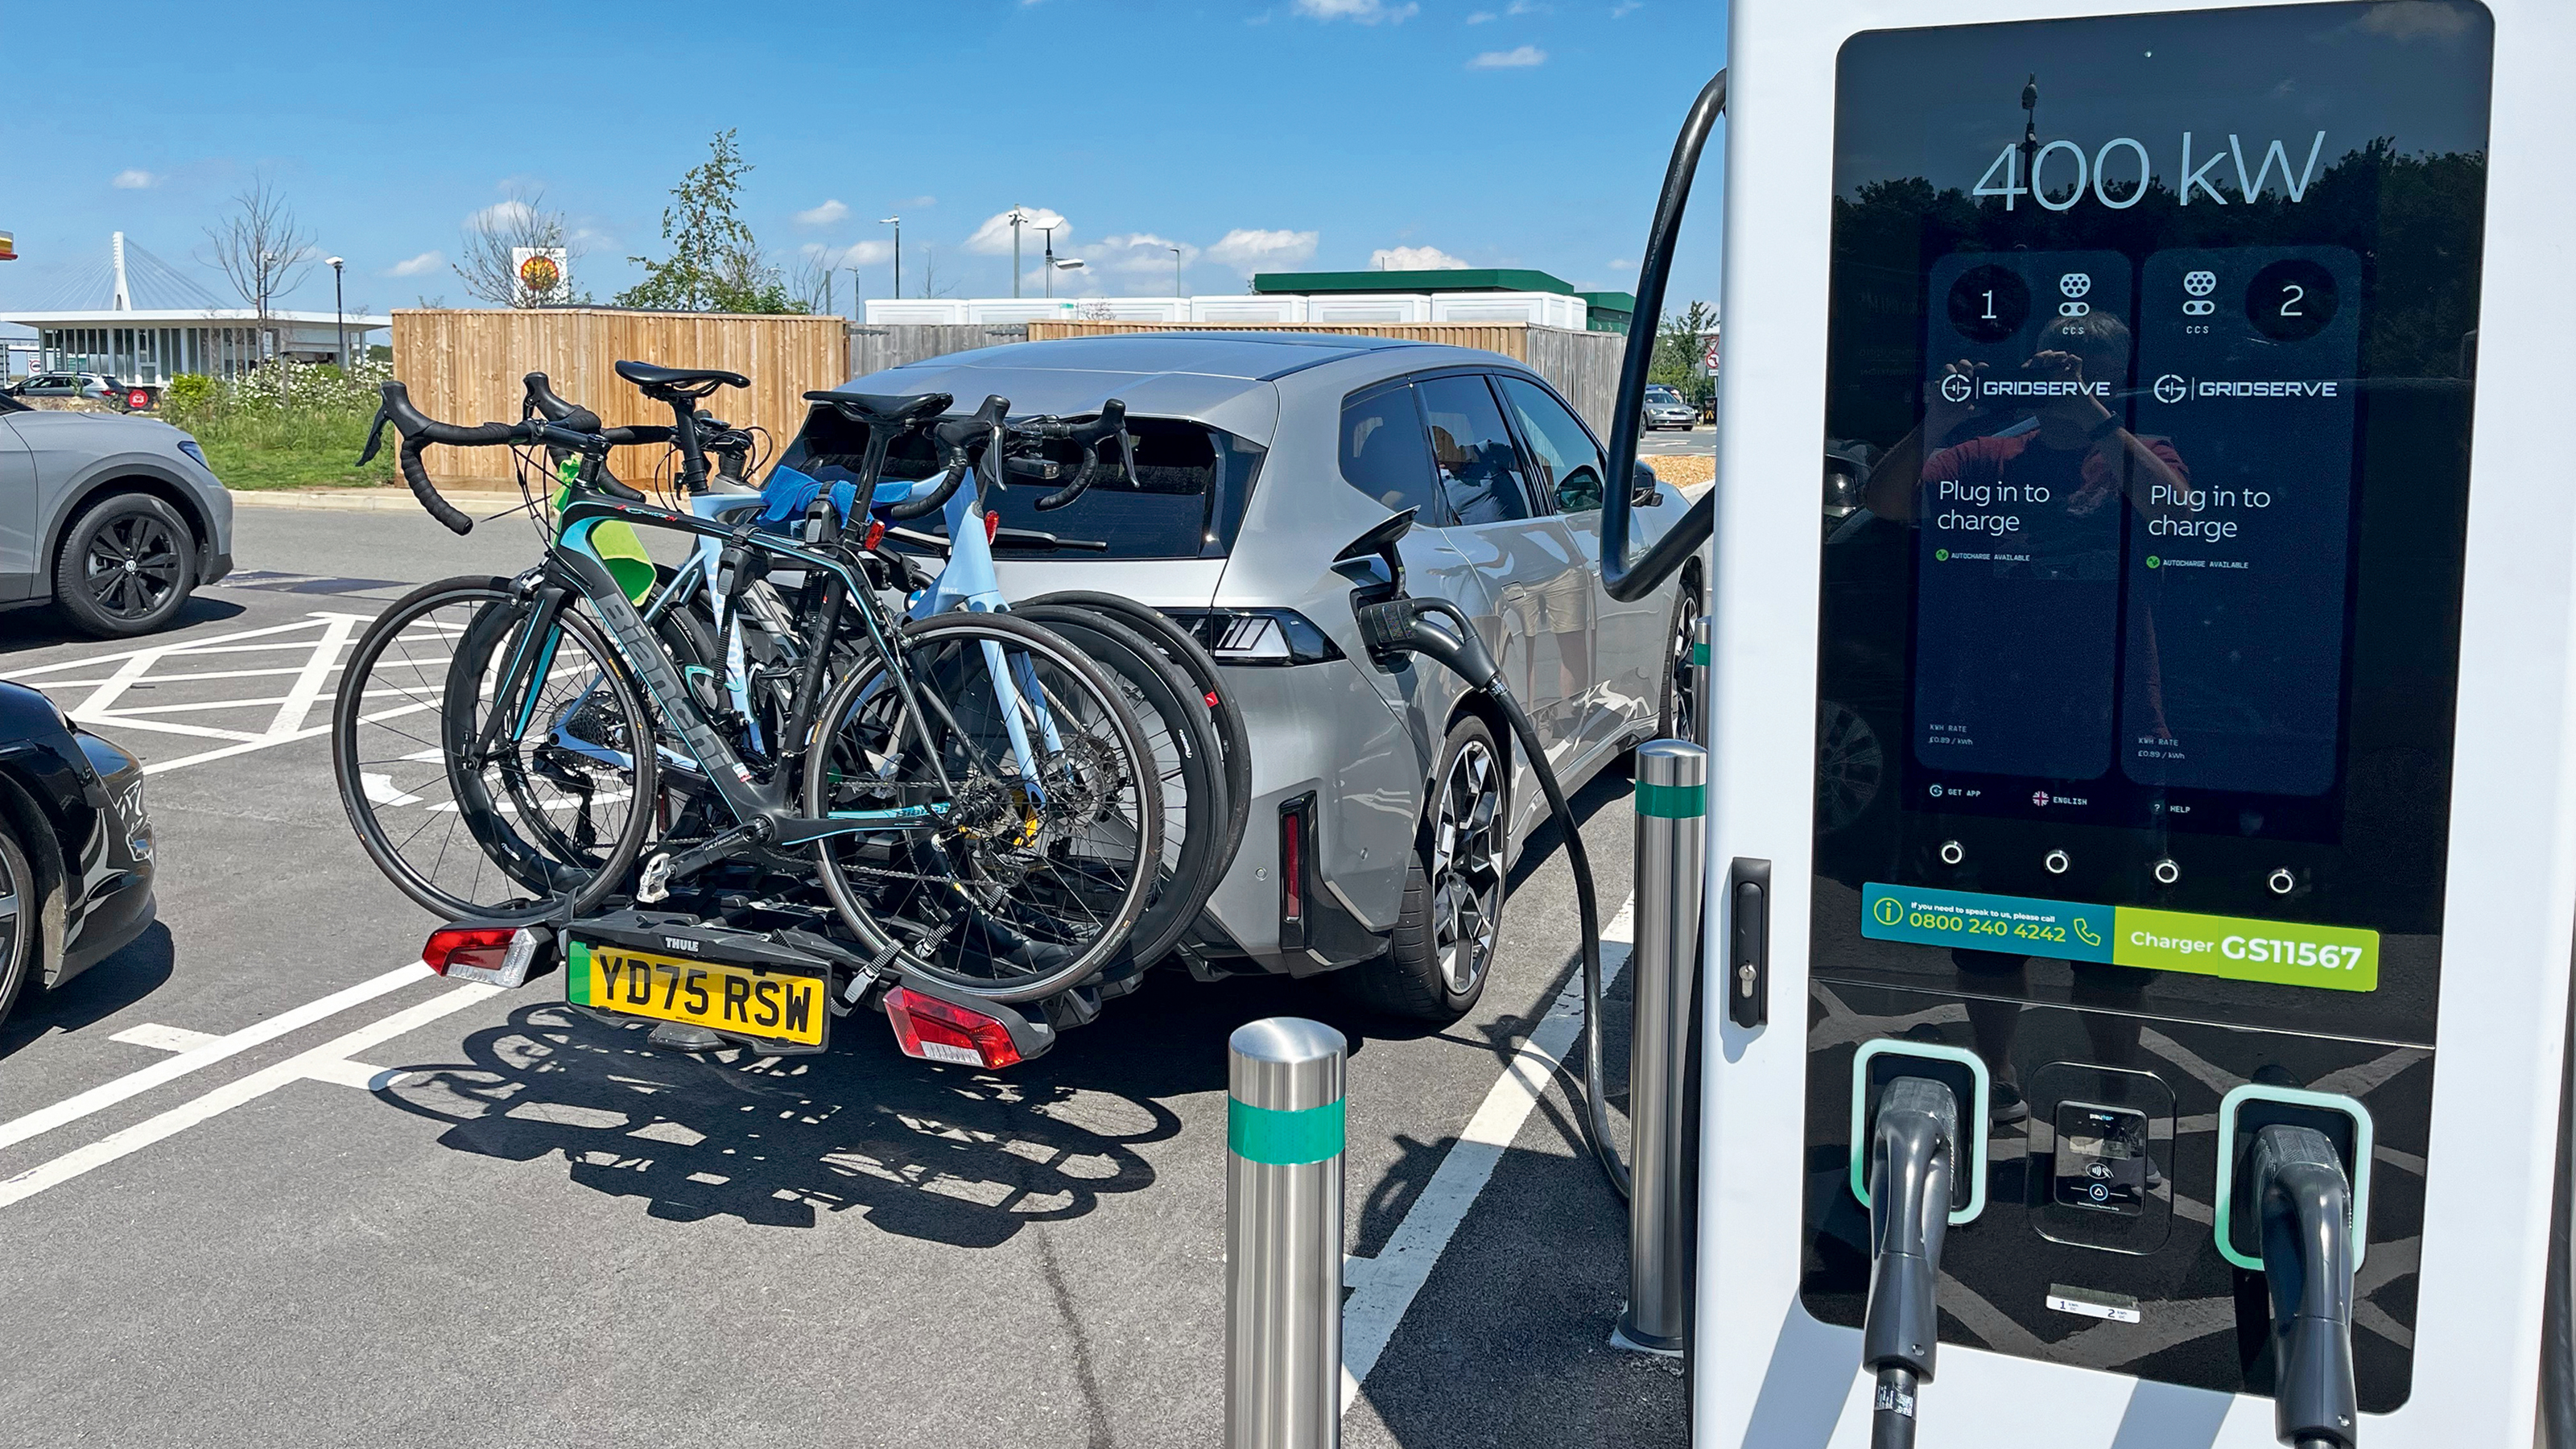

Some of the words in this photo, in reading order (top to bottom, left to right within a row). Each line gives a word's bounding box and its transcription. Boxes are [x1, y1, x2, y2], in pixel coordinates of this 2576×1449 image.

[1972, 137, 2150, 211] 400
[2180, 130, 2326, 207] kW
[1981, 290, 1997, 319] 1
[2280, 285, 2304, 316] 2
[2062, 326, 2084, 335] CCS
[2186, 325, 2209, 334] CCS
[1983, 381, 2111, 396] GRIDSERVE
[2199, 382, 2338, 397] GRIDSERVE
[1940, 480, 1990, 506] Plug
[1996, 481, 2017, 502] in
[2024, 484, 2050, 502] to
[2151, 484, 2206, 512] Plug
[2213, 485, 2235, 506] in
[2243, 488, 2271, 508] to
[1937, 509, 2020, 536] charge
[2149, 514, 2238, 543] charge
[1951, 552, 1991, 560] AUTOCHARGE
[2163, 559, 2206, 568] AUTOCHARGE
[794, 614, 830, 717] Bianchi
[595, 592, 732, 770] Bianchi
[1948, 724, 1967, 733] RATE
[2158, 738, 2179, 747] RATE
[1948, 788, 1963, 796] GET
[1967, 790, 1981, 798] APP
[2053, 796, 2087, 805] ENGLISH
[2169, 805, 2191, 813] HELP
[1934, 905, 1955, 913] need
[1955, 906, 1964, 914] to
[1965, 907, 1989, 916] speak
[1990, 910, 2000, 918] to
[2000, 911, 2013, 919] us,
[2013, 913, 2040, 923] please
[1909, 912, 1963, 931] 0800
[1968, 919, 2008, 936] 240
[2013, 923, 2066, 943] 4242
[665, 936, 700, 952] THULE
[2130, 931, 2215, 954] Charger
[2221, 935, 2363, 970] GS11567
[599, 954, 708, 1016] YD75
[724, 974, 811, 1034] RSW
[2060, 1300, 2066, 1310] 1
[2107, 1308, 2116, 1318] 2
